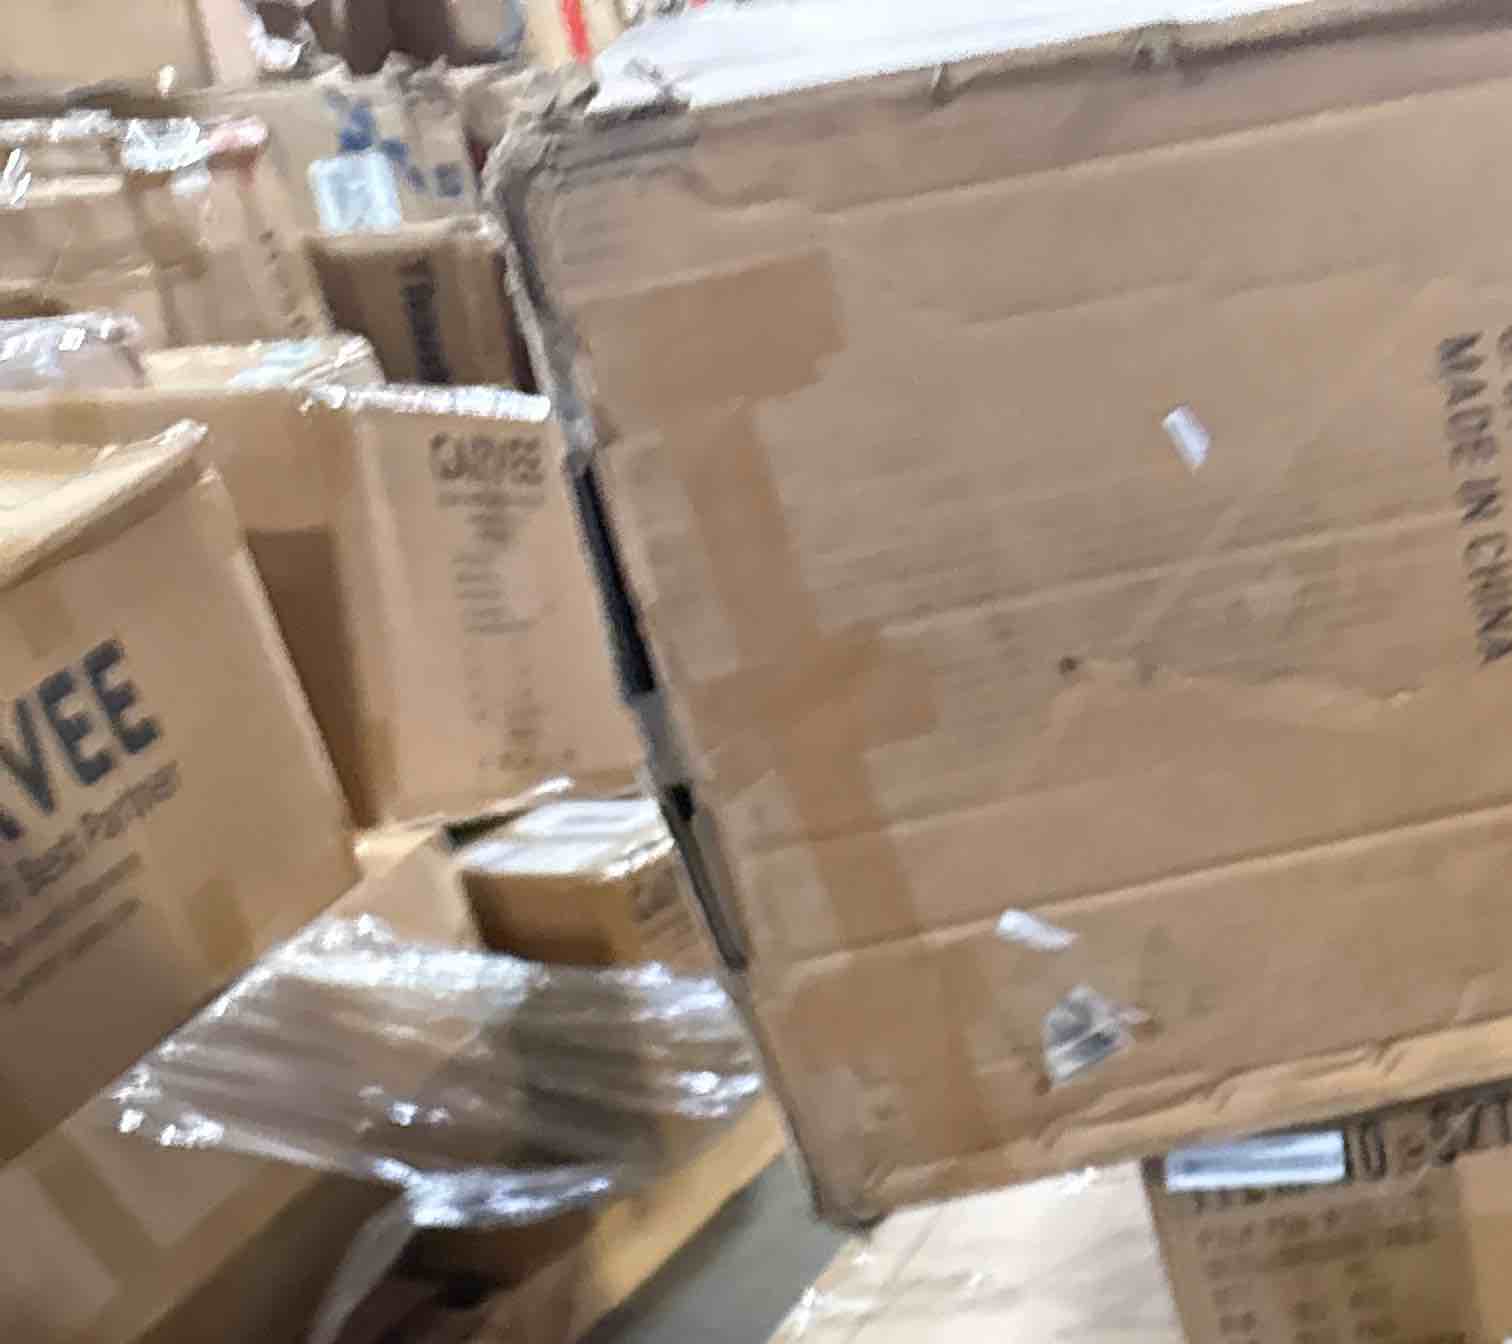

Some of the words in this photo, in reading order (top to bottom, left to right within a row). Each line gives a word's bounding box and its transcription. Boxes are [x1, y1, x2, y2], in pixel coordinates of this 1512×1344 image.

[1436, 331, 1498, 466] MADE
[1455, 476, 1502, 526] IN
[0, 638, 161, 842] VEE
